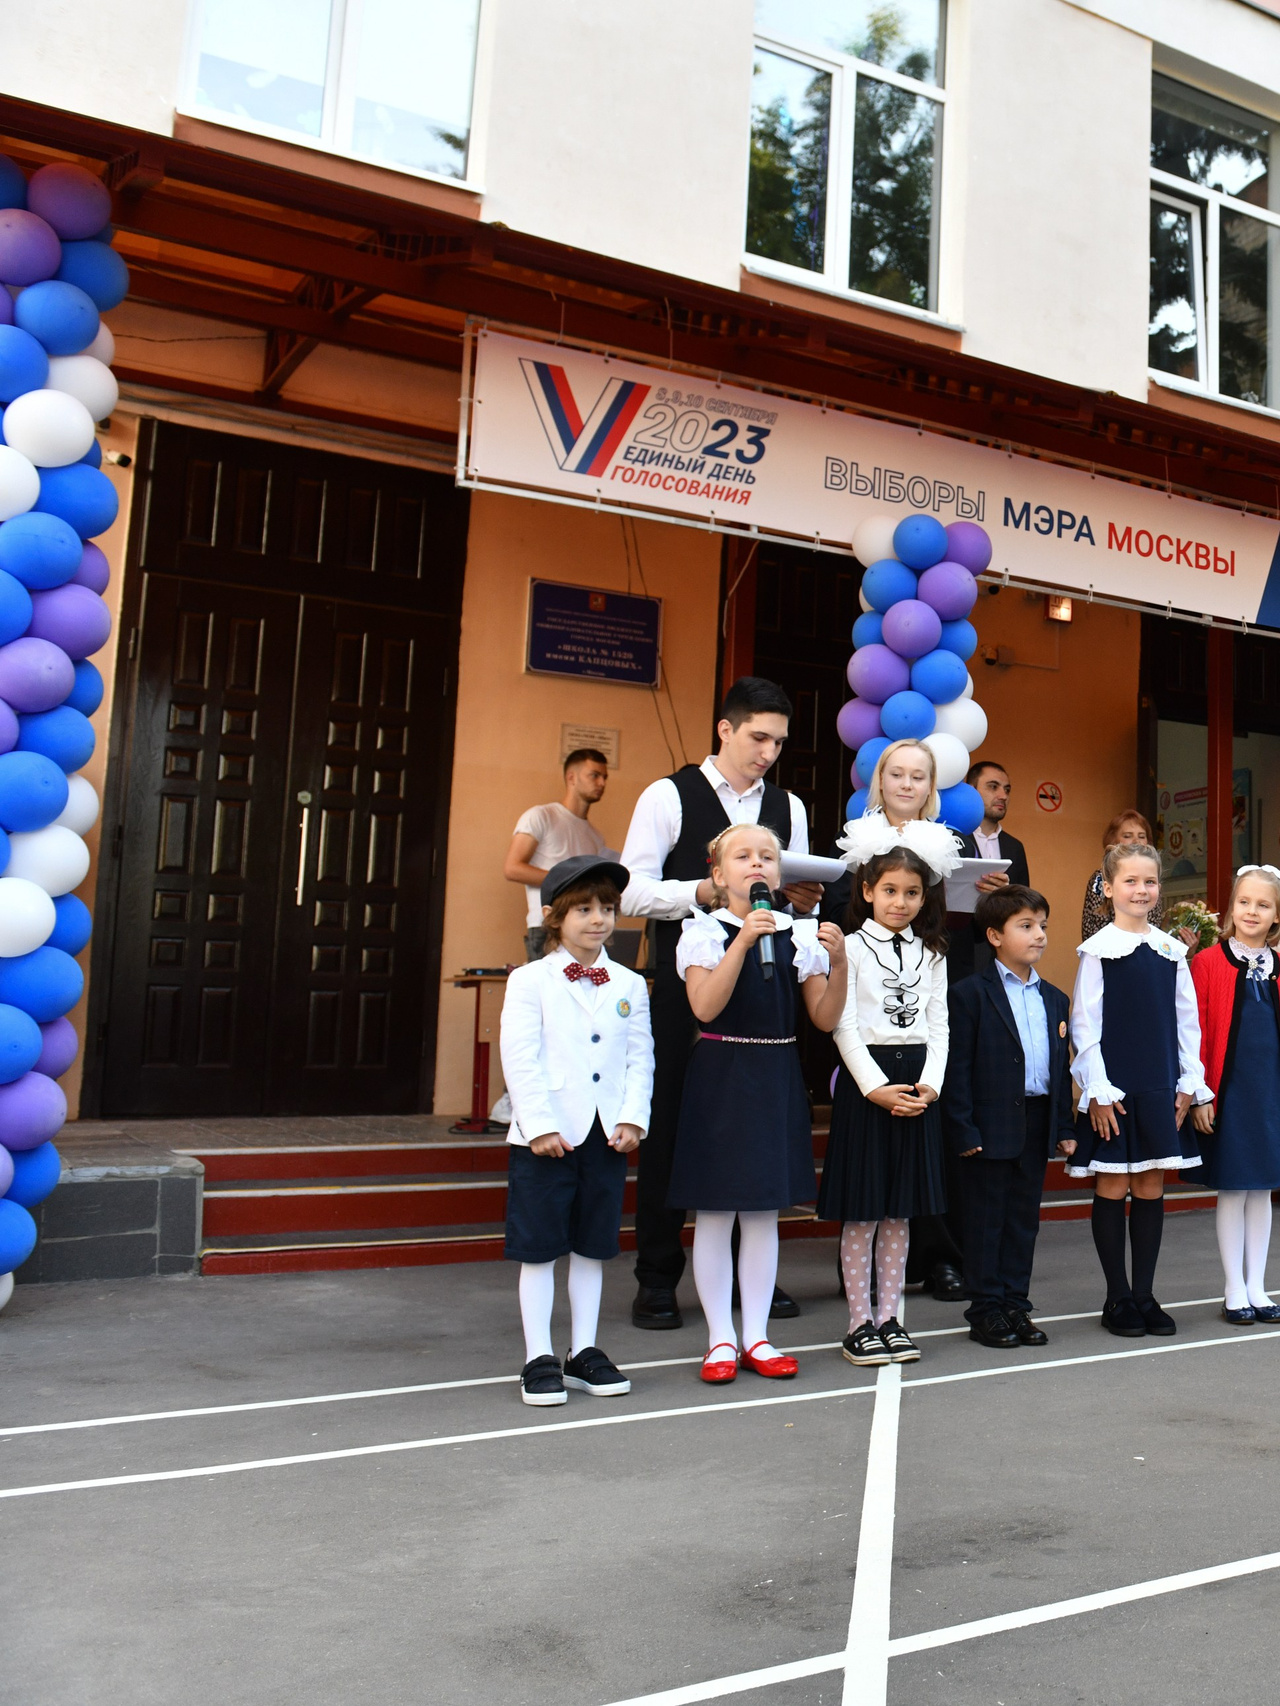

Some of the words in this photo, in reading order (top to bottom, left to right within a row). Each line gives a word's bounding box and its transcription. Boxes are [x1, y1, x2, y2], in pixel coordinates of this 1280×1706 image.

[655, 387, 704, 409] 8,9,10
[705, 398, 778, 425] СЕНТЯБРЯ
[633, 403, 771, 465] 2023
[610, 465, 752, 506] ГОЛОСОВАНИЯ
[622, 445, 707, 475] ЕДИНЫЙ
[707, 463, 756, 485] ДЕНЬ
[824, 456, 986, 521] ВЫБОРЫ
[1003, 497, 1096, 546] МЭРА
[1107, 522, 1236, 577] МОСКВЫ
